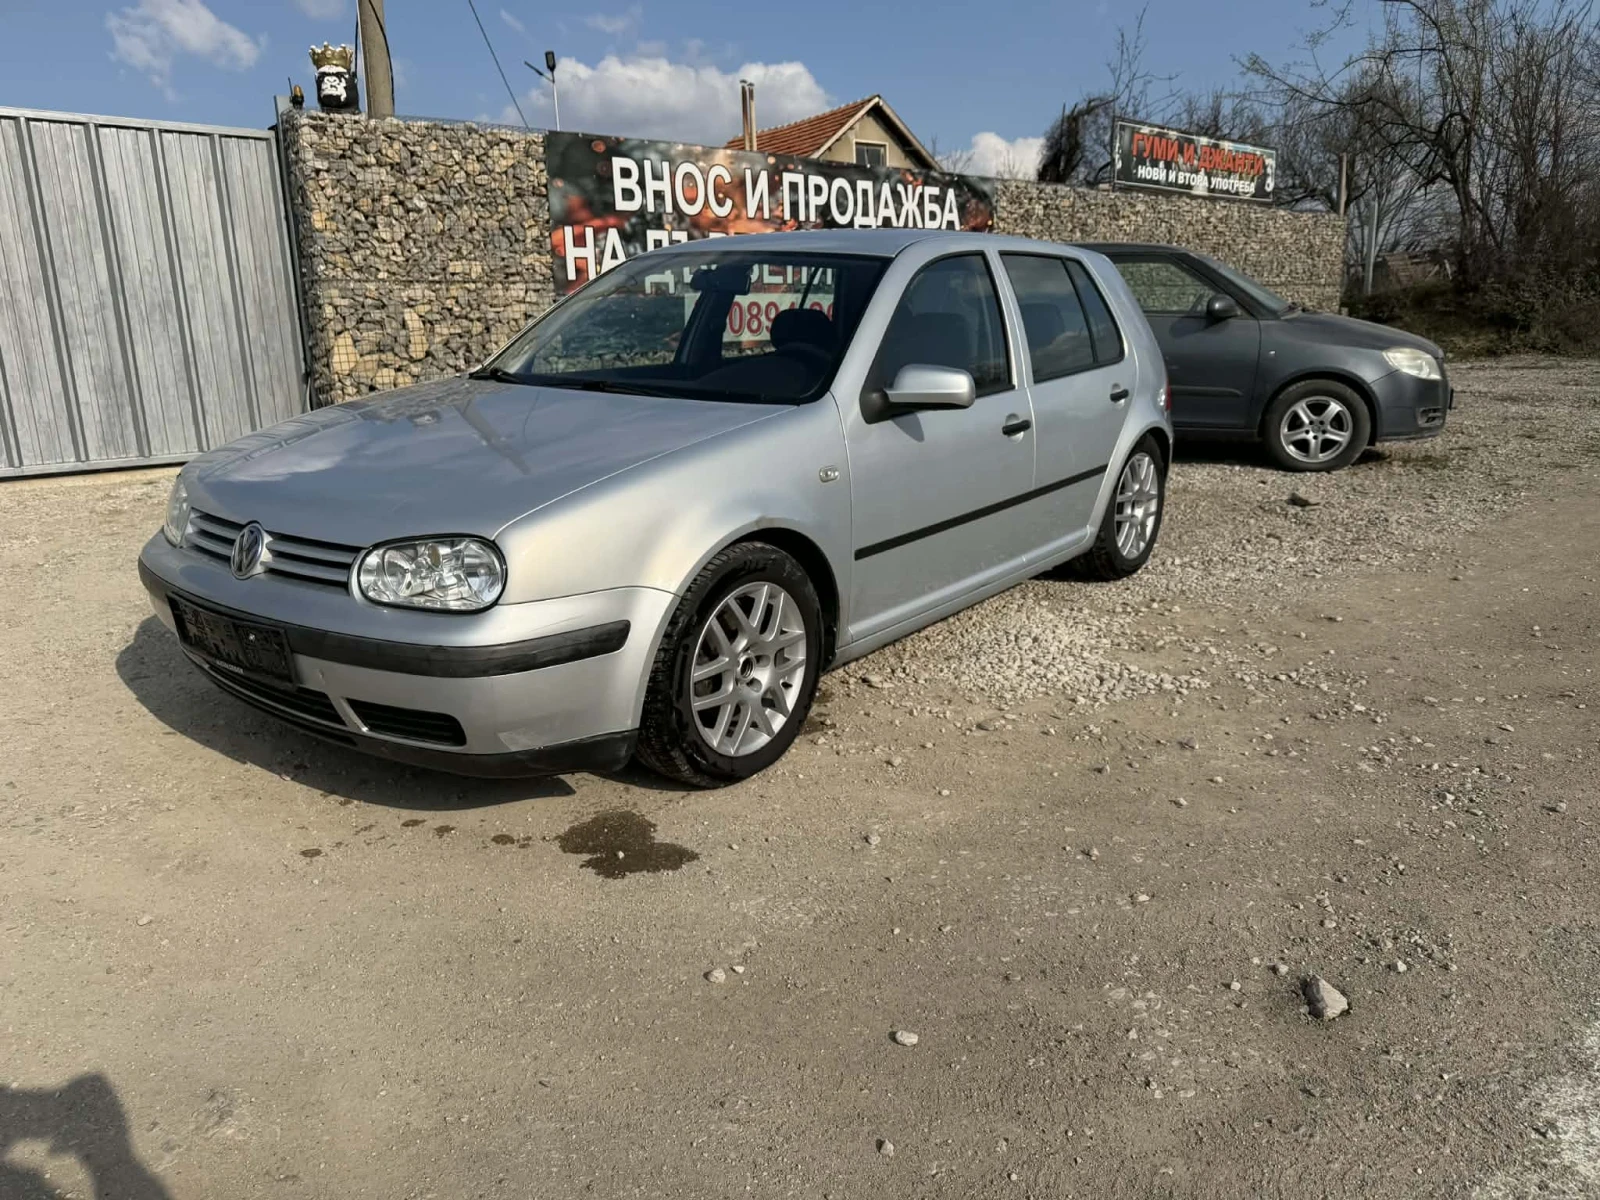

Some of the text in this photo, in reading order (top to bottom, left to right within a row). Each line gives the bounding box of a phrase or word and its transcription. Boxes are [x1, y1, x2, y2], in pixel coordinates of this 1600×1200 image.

[1132, 132, 1265, 176] ГУМИ И ДЖАНТИ
[611, 156, 961, 231] ВНОС И ПРОДАЖБА
[1137, 164, 1256, 193] НОВИ И ВТОРА УПОТРЕБА
[563, 225, 627, 281] НА
[728, 301, 797, 335] 089
